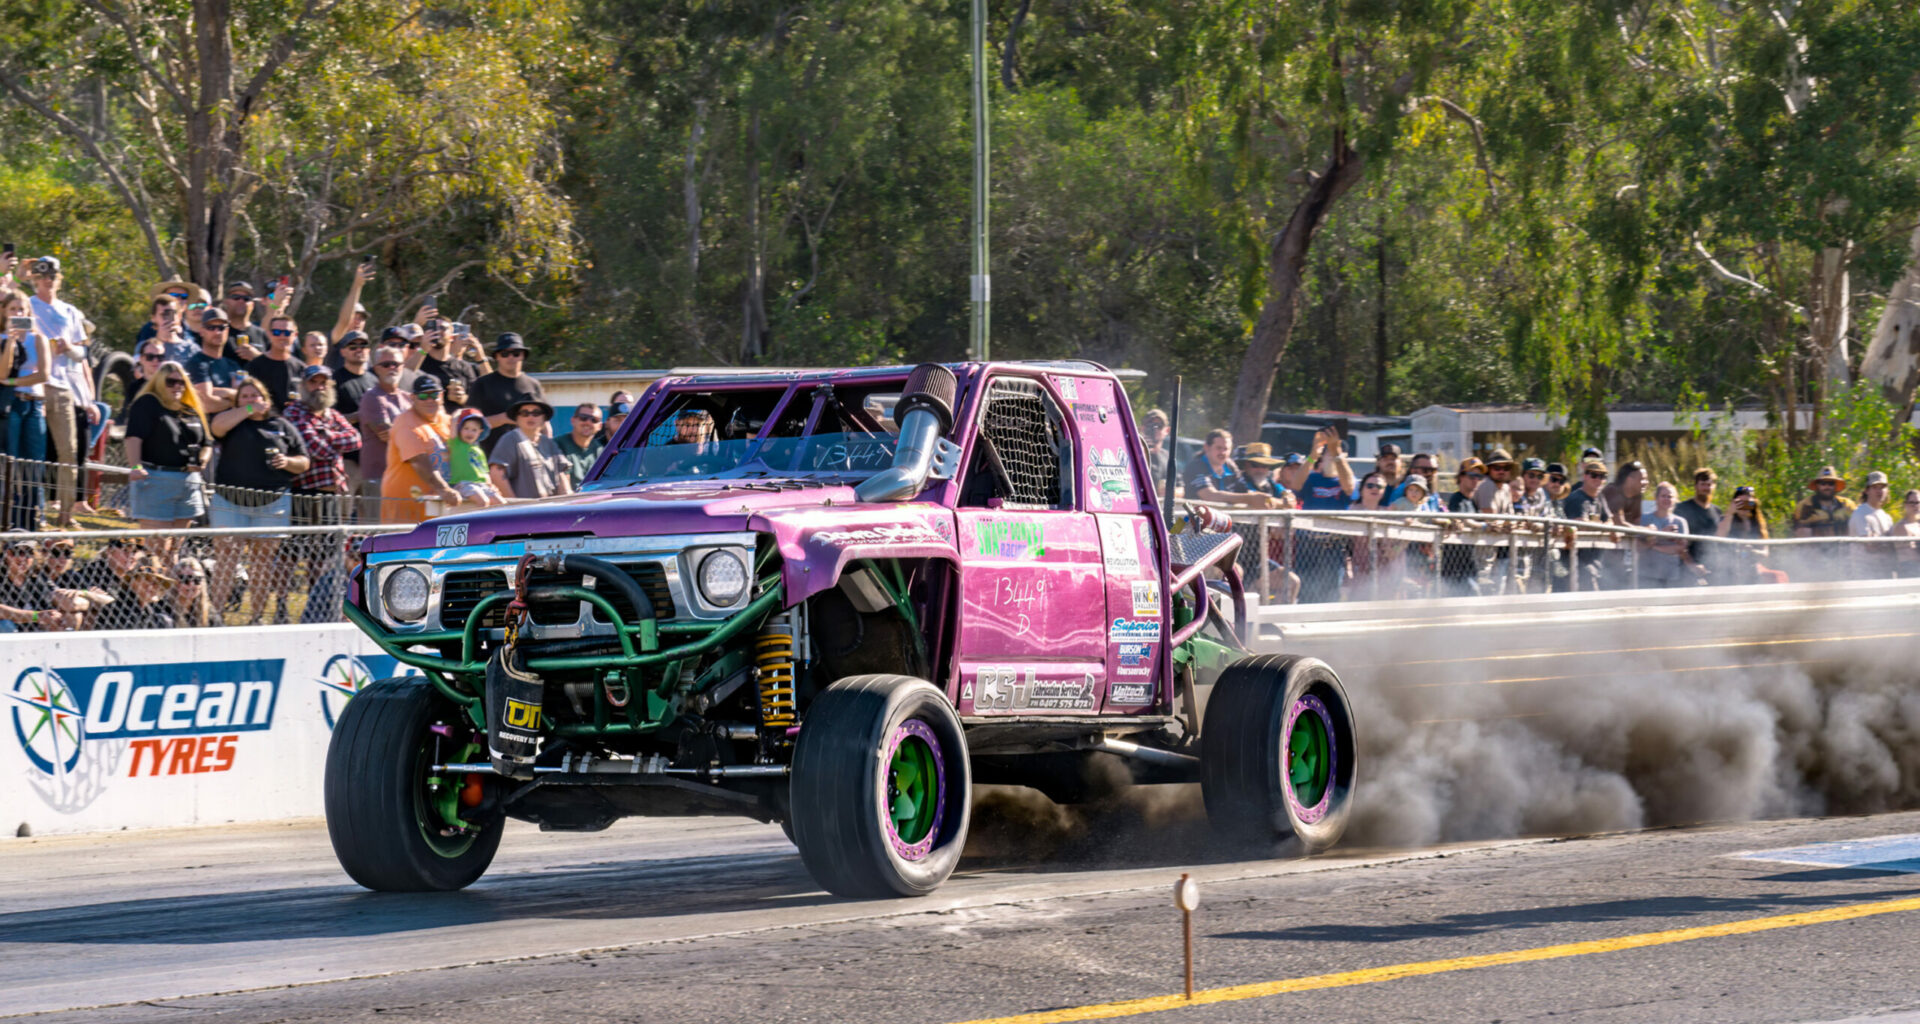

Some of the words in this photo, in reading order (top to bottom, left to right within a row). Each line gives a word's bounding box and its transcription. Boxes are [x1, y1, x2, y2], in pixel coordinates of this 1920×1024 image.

[437, 525, 467, 547] 76
[1106, 557, 1138, 566] REVOLUTION
[994, 576, 1045, 612] 13449
[1016, 613, 1031, 636] D
[1112, 618, 1159, 632] Superior
[976, 669, 1034, 711] CSJ
[85, 671, 273, 734] Ocean
[498, 731, 529, 743] RECOVERY
[128, 735, 239, 777] TYRES
